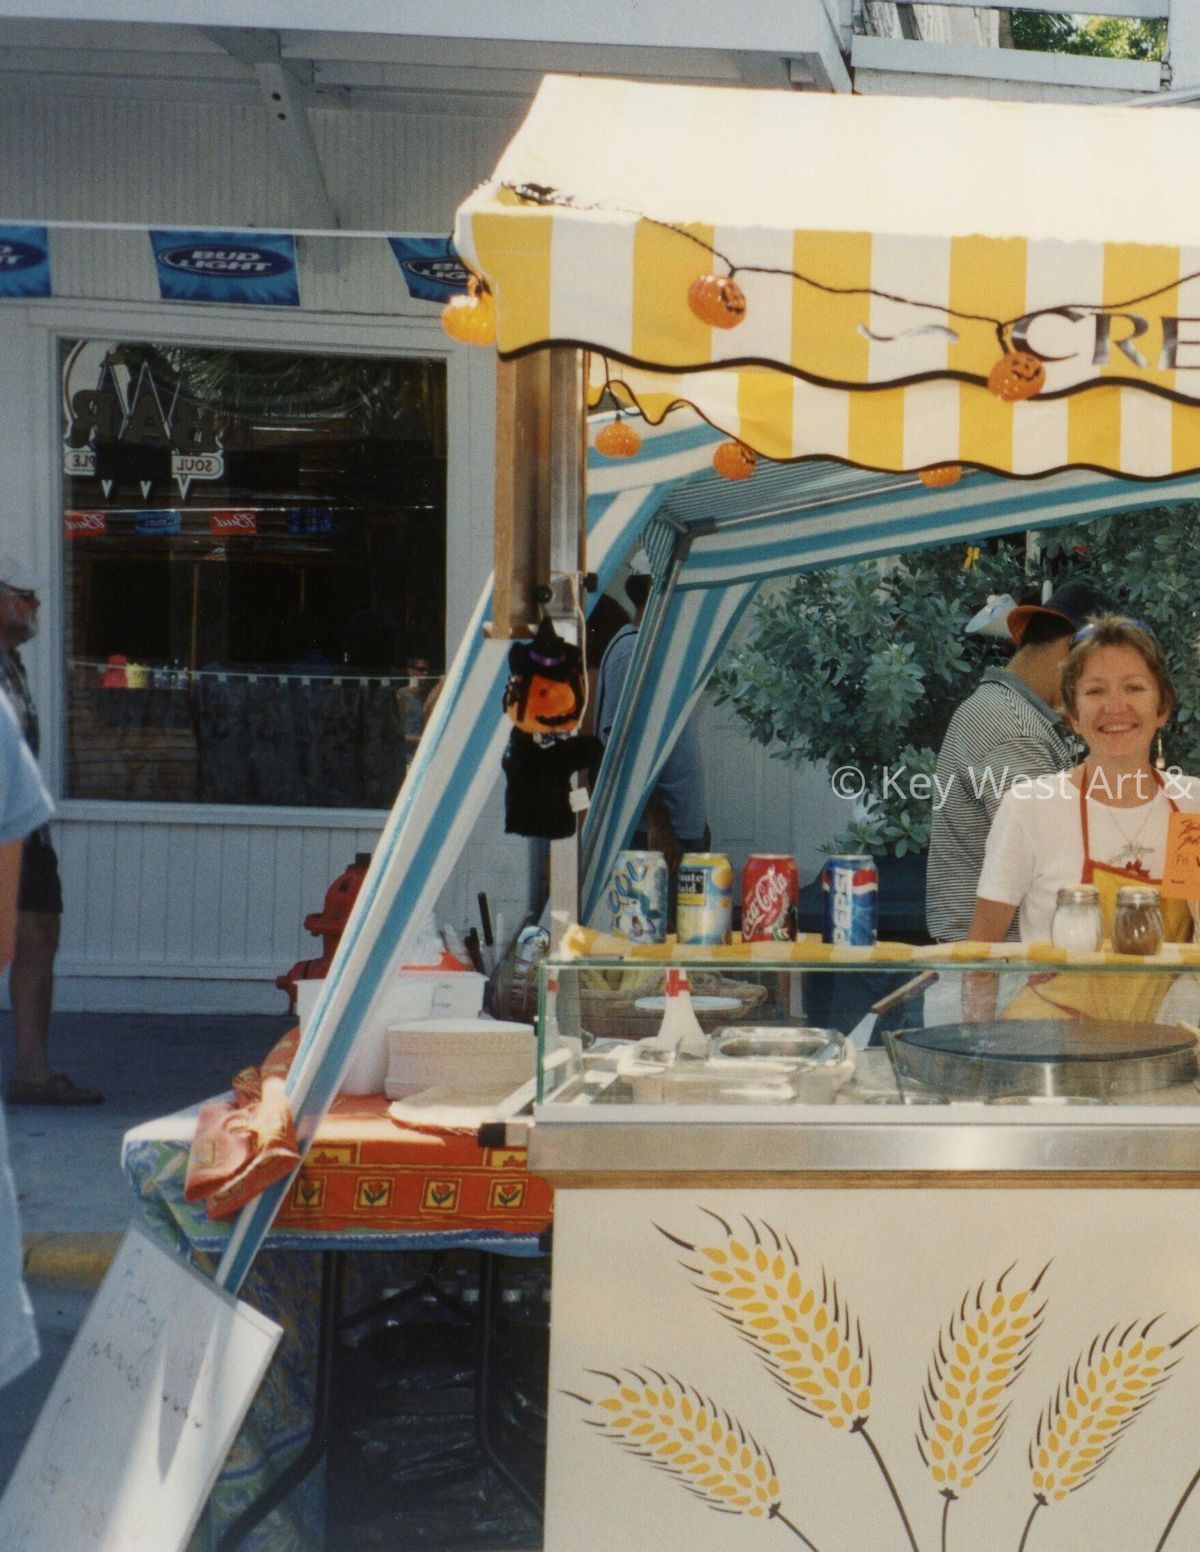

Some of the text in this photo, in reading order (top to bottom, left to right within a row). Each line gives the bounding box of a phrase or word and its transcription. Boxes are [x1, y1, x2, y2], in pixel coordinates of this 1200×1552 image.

[191, 250, 261, 261] BUD
[177, 259, 272, 272] LIGHT
[422, 269, 467, 280] LIG
